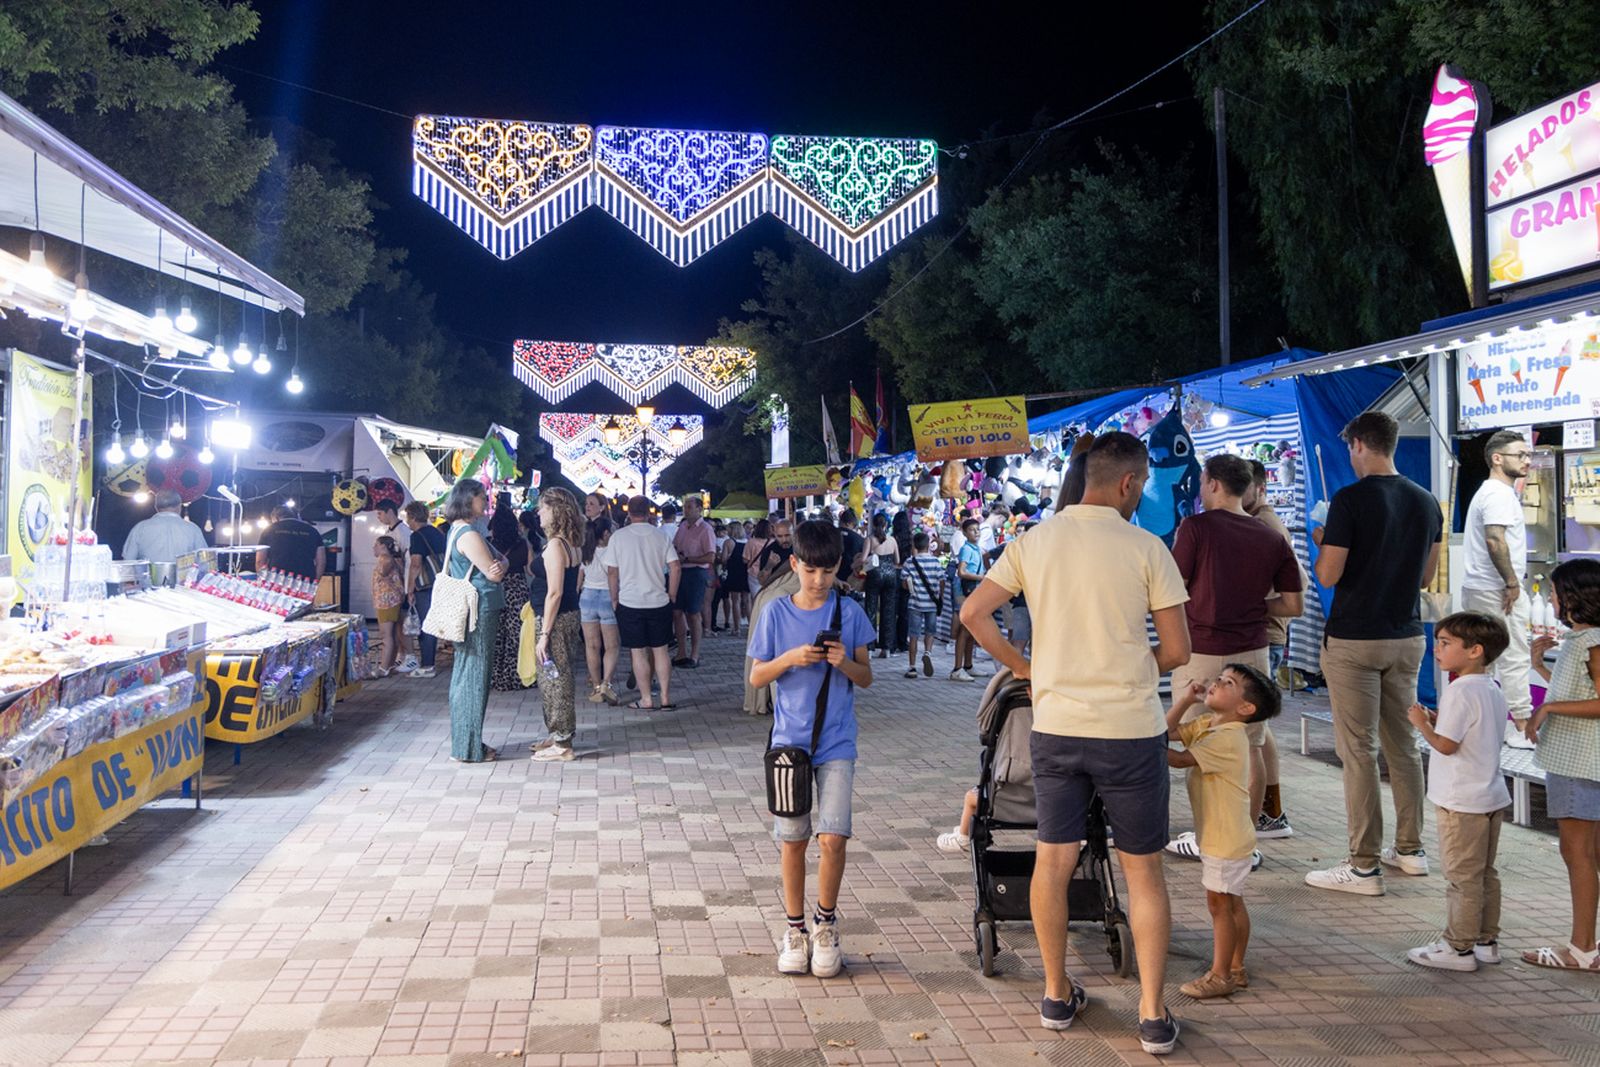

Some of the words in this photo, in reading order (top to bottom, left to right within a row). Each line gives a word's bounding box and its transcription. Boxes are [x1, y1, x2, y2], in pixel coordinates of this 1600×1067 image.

[1488, 90, 1592, 198] HELADOS
[1467, 364, 1501, 380] Nata
[1528, 356, 1571, 372] Fresa
[1497, 379, 1538, 395] Pitufo
[1462, 404, 1498, 417] Leche
[1501, 391, 1580, 412] Merengada
[921, 425, 968, 436] CASETA
[971, 423, 988, 431] DE
[991, 421, 1018, 429] TIRO
[925, 416, 955, 428] VIVA
[957, 411, 973, 420] LA
[977, 411, 1014, 422] FERIA
[935, 437, 949, 447] EL
[953, 435, 975, 445] TIO
[980, 432, 1012, 443] LOLO
[92, 752, 136, 811] DE
